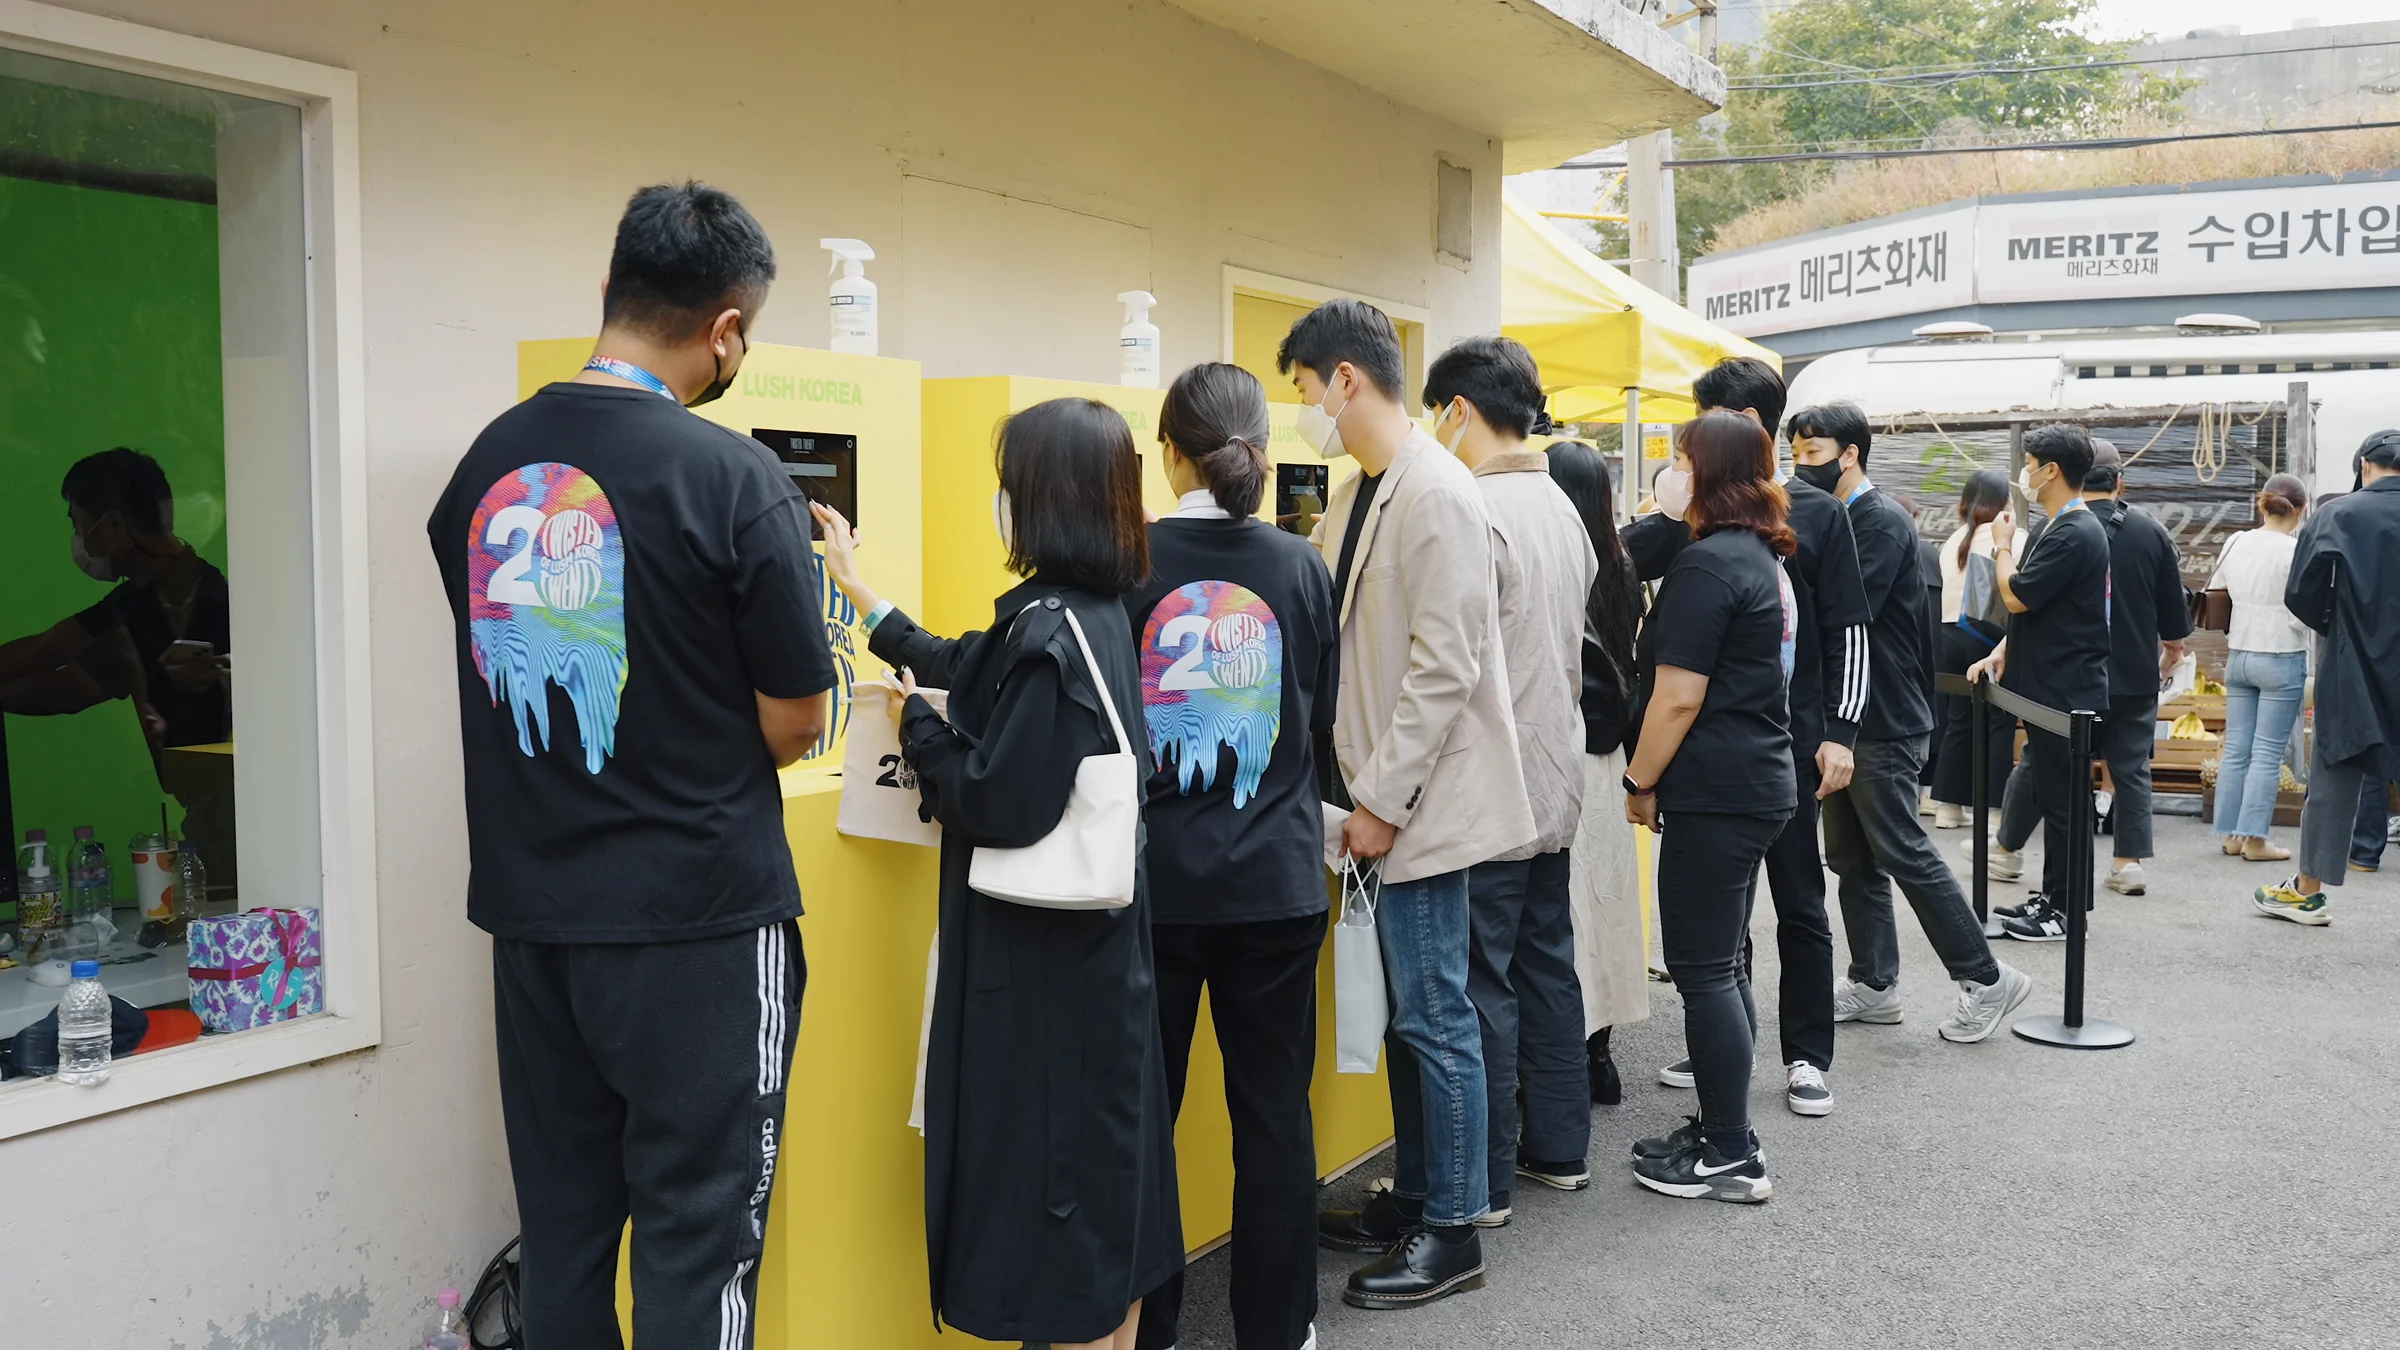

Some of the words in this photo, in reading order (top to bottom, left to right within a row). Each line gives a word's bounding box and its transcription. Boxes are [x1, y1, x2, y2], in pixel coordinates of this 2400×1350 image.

[2008, 231, 2159, 261] MERITZ
[1706, 283, 1791, 321] MERITZ
[1800, 231, 1947, 303] 메리츠화재
[2067, 257, 2159, 278] 메리츠화재
[742, 372, 795, 399] LUSH
[800, 377, 864, 406] KOREA
[826, 622, 856, 661] OREA
[1211, 613, 1267, 652] TWISTED
[1211, 651, 1267, 689] TWENTY
[750, 1117, 777, 1206] adidas
